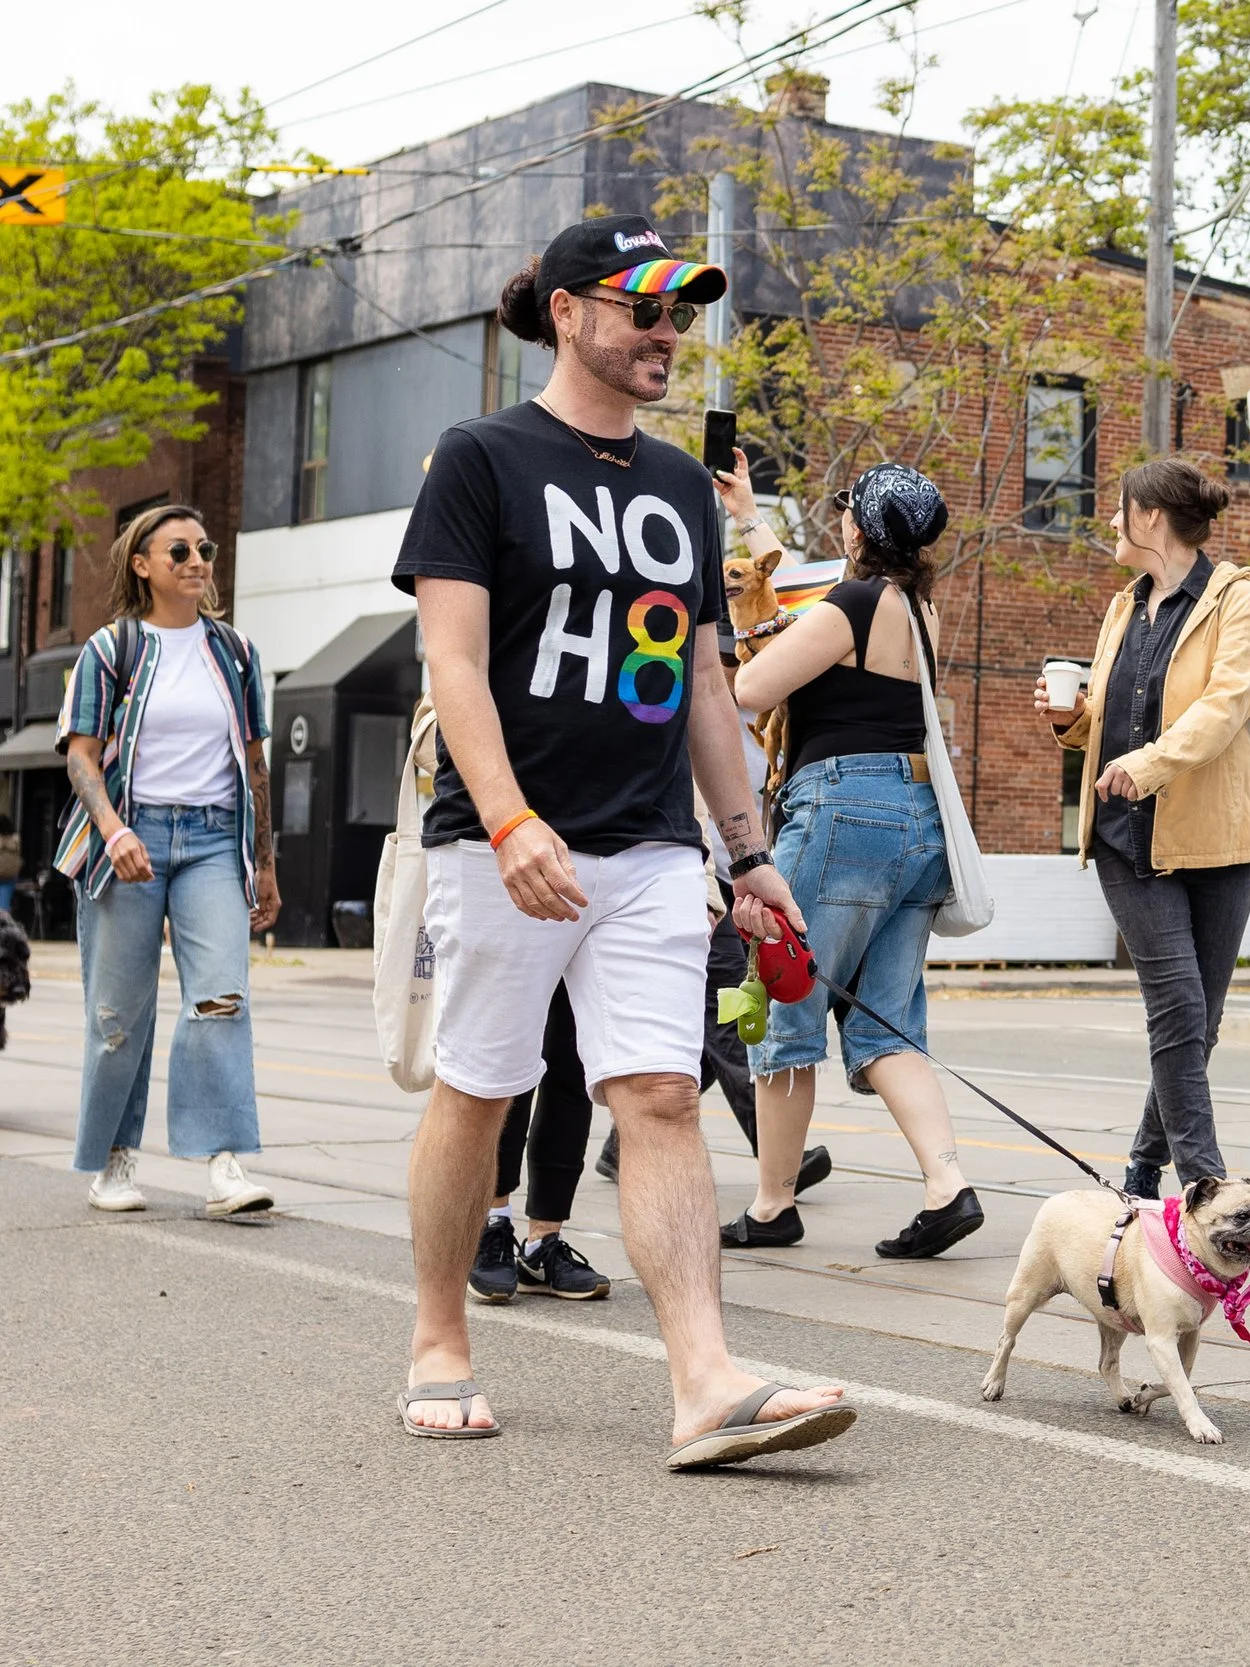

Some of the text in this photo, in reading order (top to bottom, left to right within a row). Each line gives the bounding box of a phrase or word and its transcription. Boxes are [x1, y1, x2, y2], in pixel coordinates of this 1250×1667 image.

[613, 231, 651, 253] love
[543, 483, 694, 586] NO
[529, 583, 690, 724] H8
